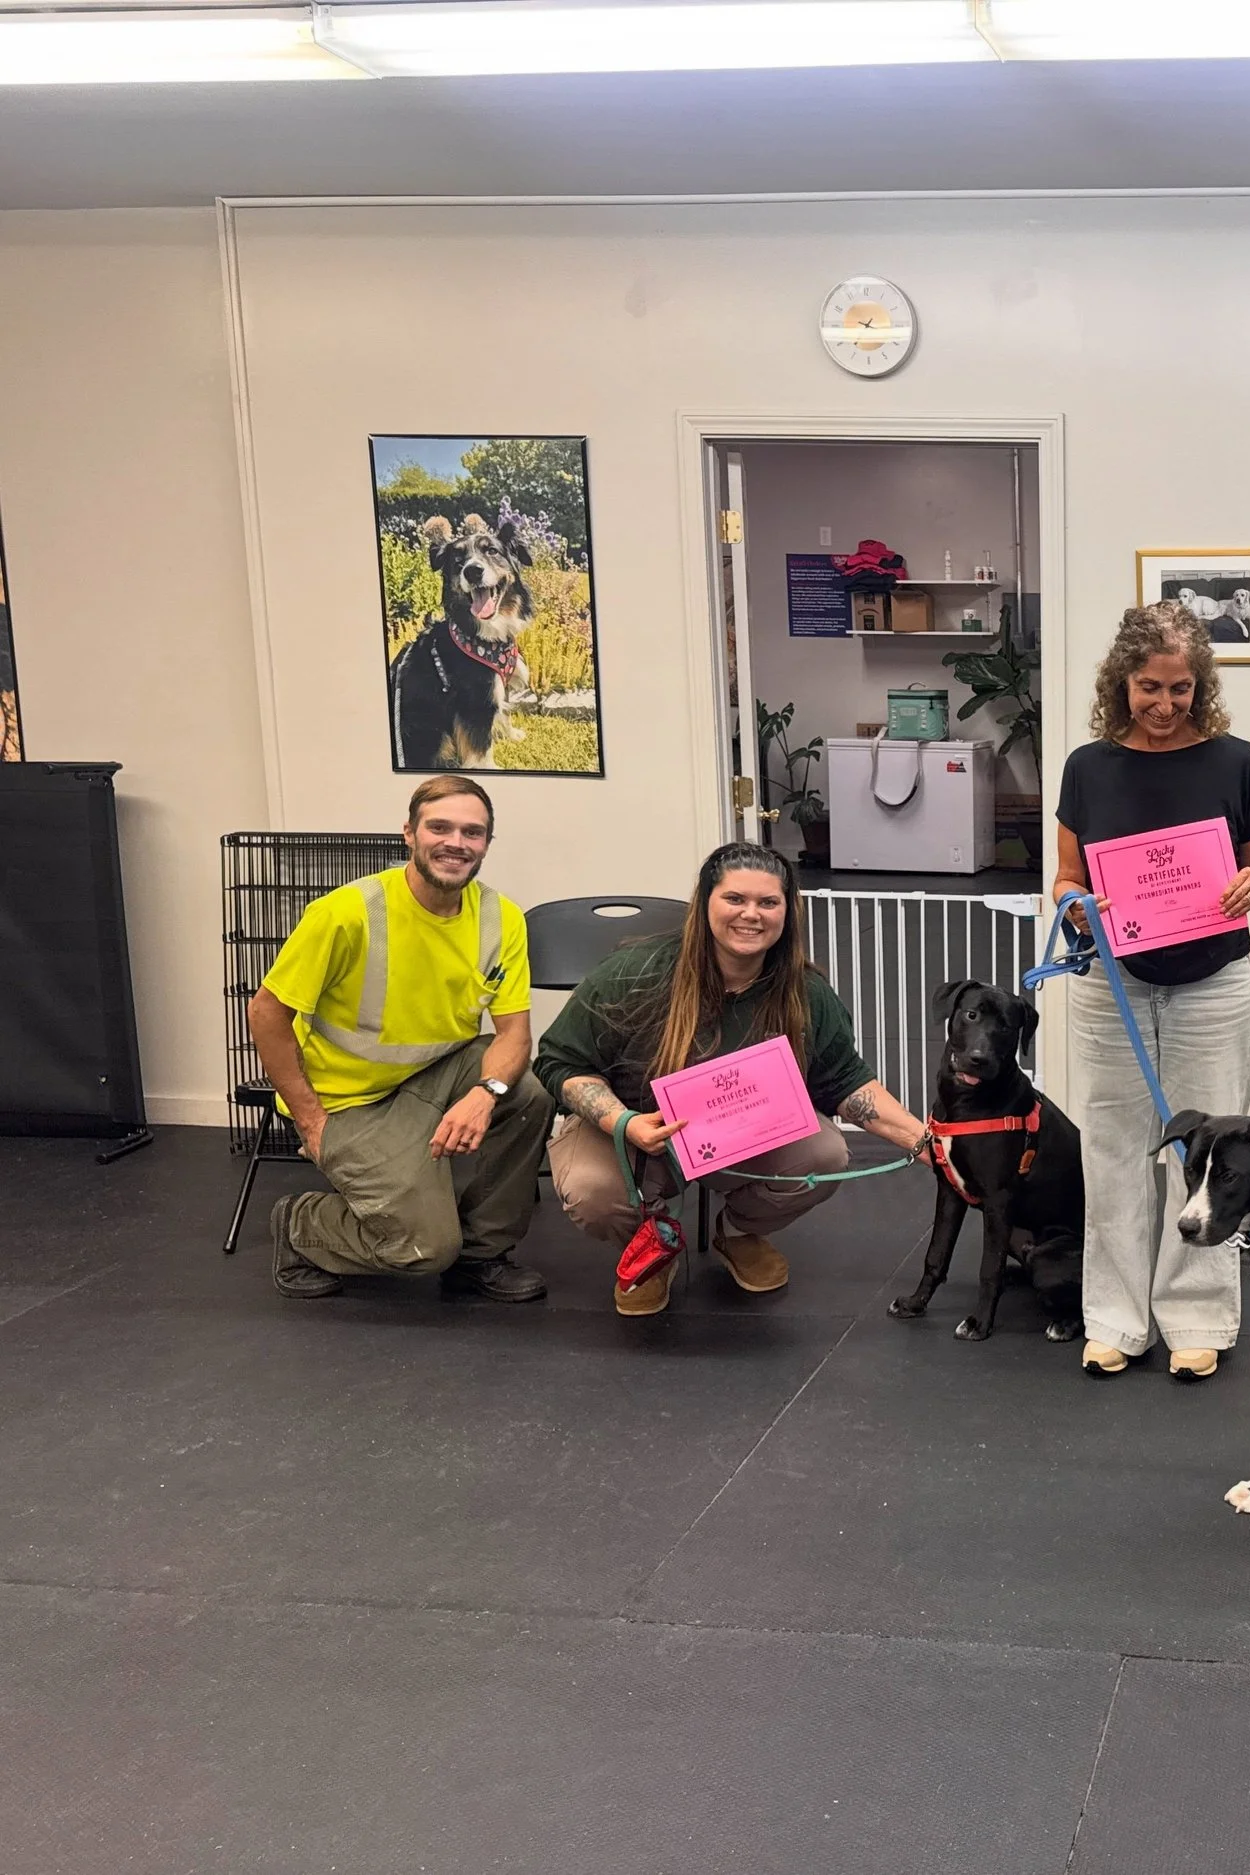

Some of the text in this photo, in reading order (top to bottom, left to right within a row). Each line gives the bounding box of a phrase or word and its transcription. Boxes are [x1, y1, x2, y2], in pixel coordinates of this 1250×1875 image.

[1146, 844, 1175, 864] Lucky
[1156, 855, 1173, 868] Dog
[1137, 864, 1191, 885] CERTIFICATE
[1134, 881, 1201, 901] INTERMEDIATE MANNERS
[712, 1068, 739, 1088] Lucky
[723, 1078, 739, 1092] Dog
[706, 1083, 759, 1110] CERTIFICATE
